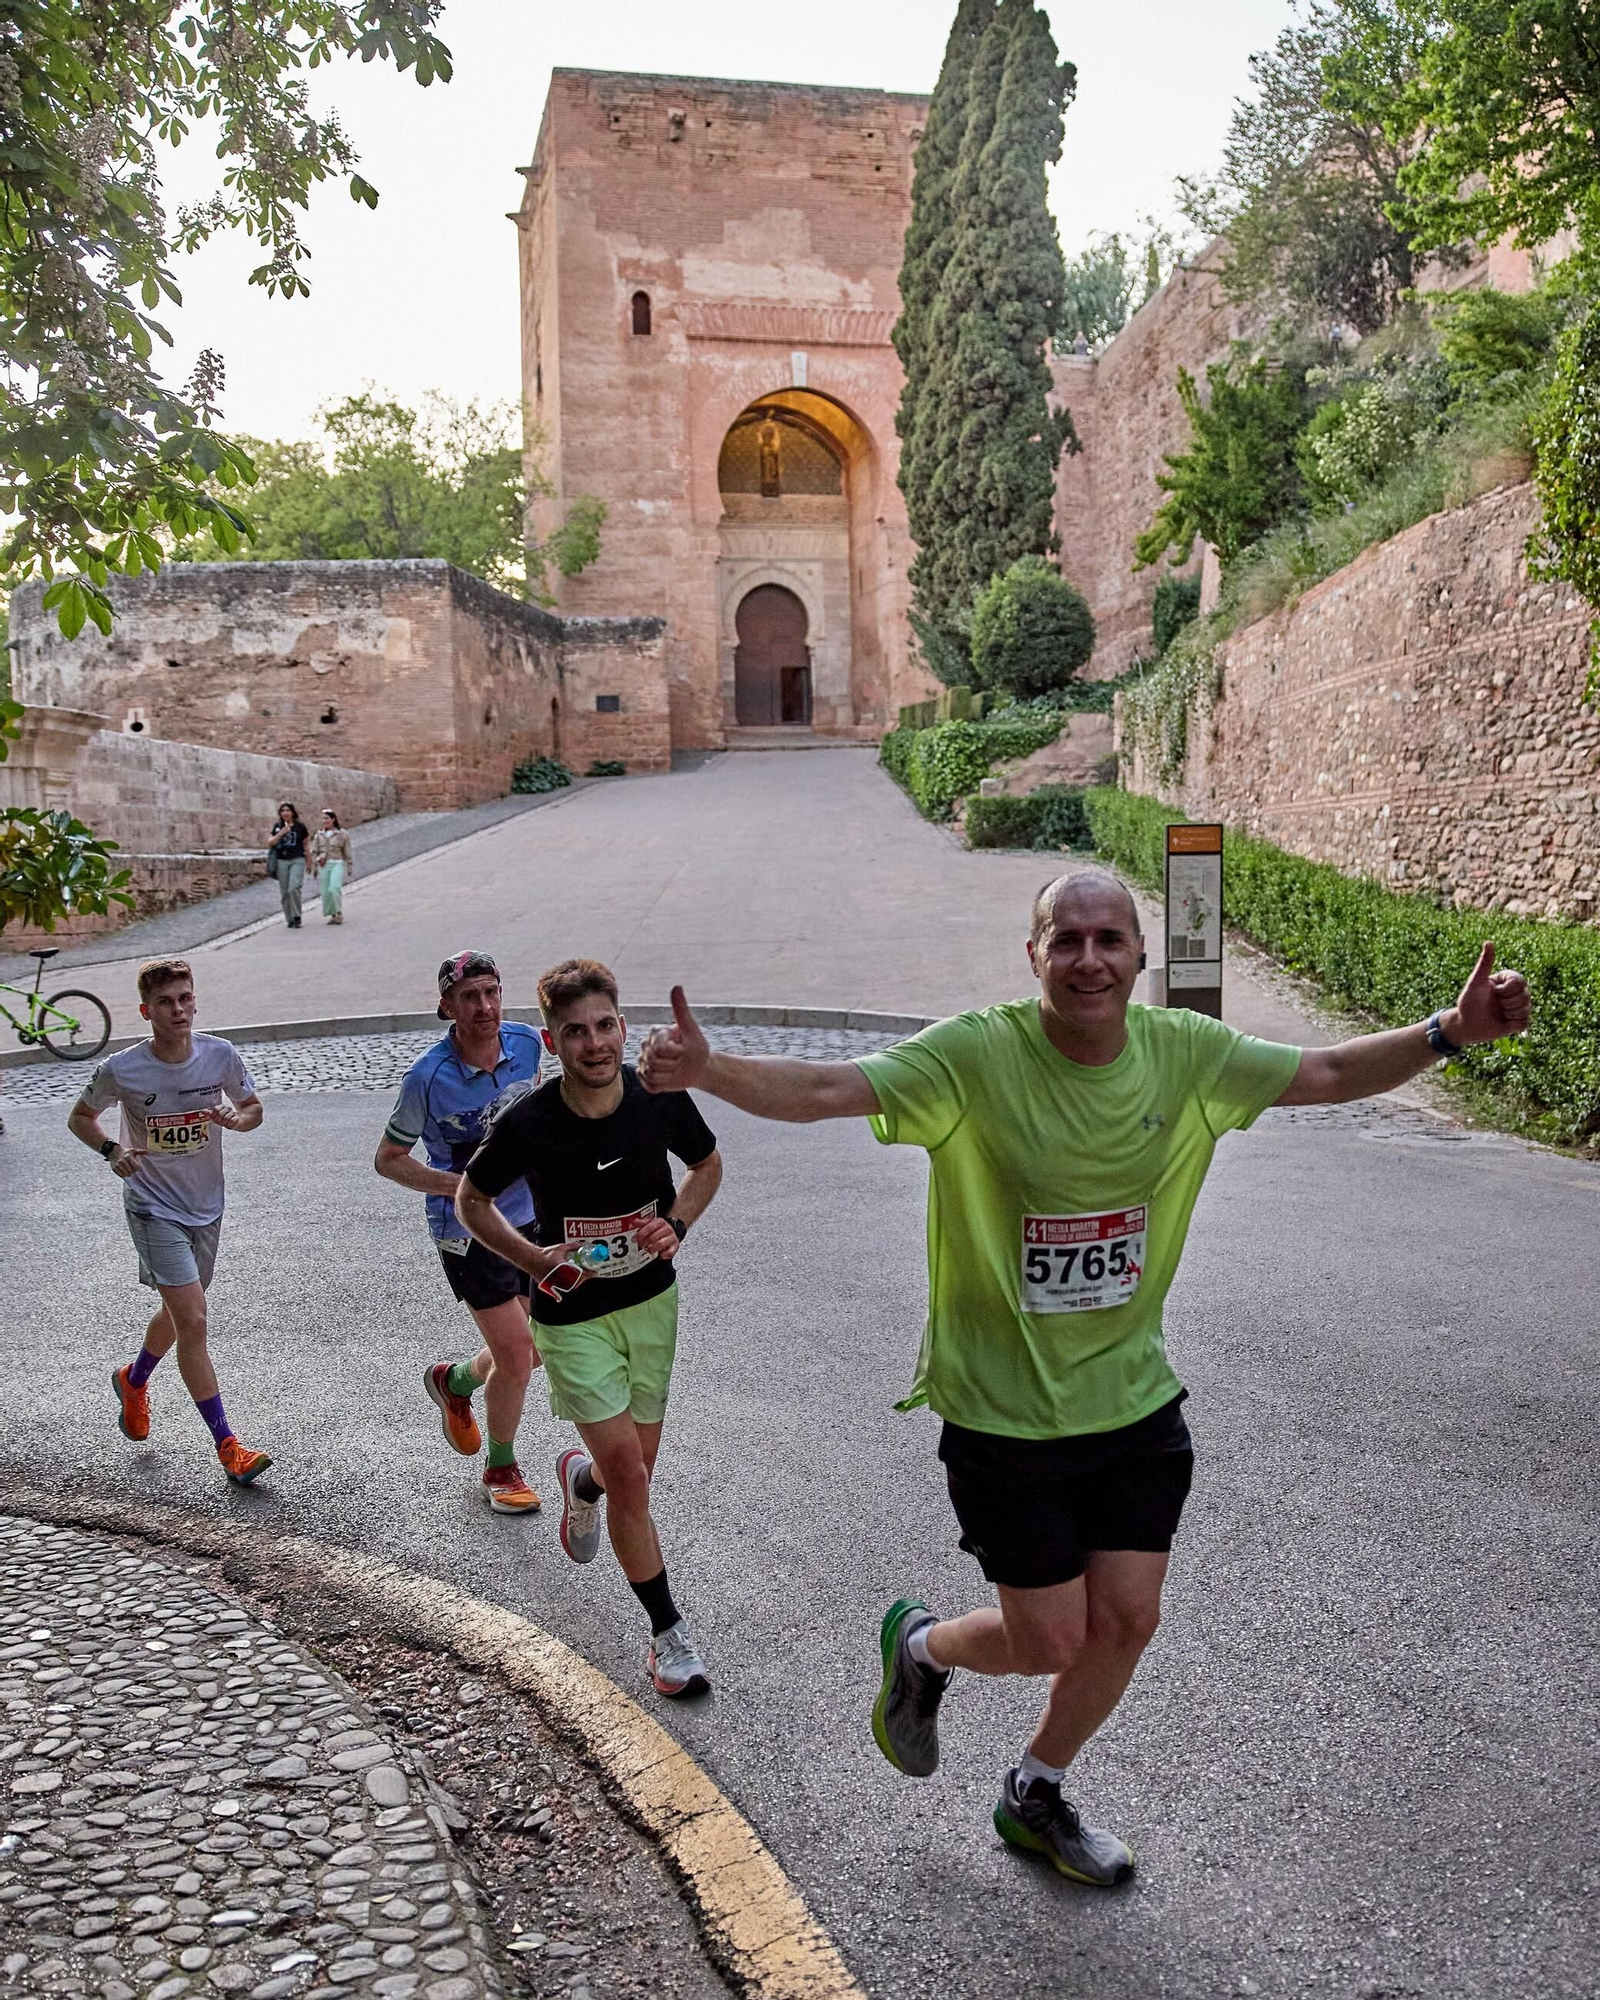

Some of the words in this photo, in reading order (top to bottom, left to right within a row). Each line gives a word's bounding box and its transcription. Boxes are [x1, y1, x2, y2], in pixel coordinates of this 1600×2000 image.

[148, 1118, 160, 1127] 41
[150, 1125, 202, 1145] 1405
[568, 1221, 584, 1237] 41
[584, 1221, 599, 1231] MEDIA
[1026, 1221, 1048, 1242] 41
[1025, 1240, 1129, 1284] 5765
